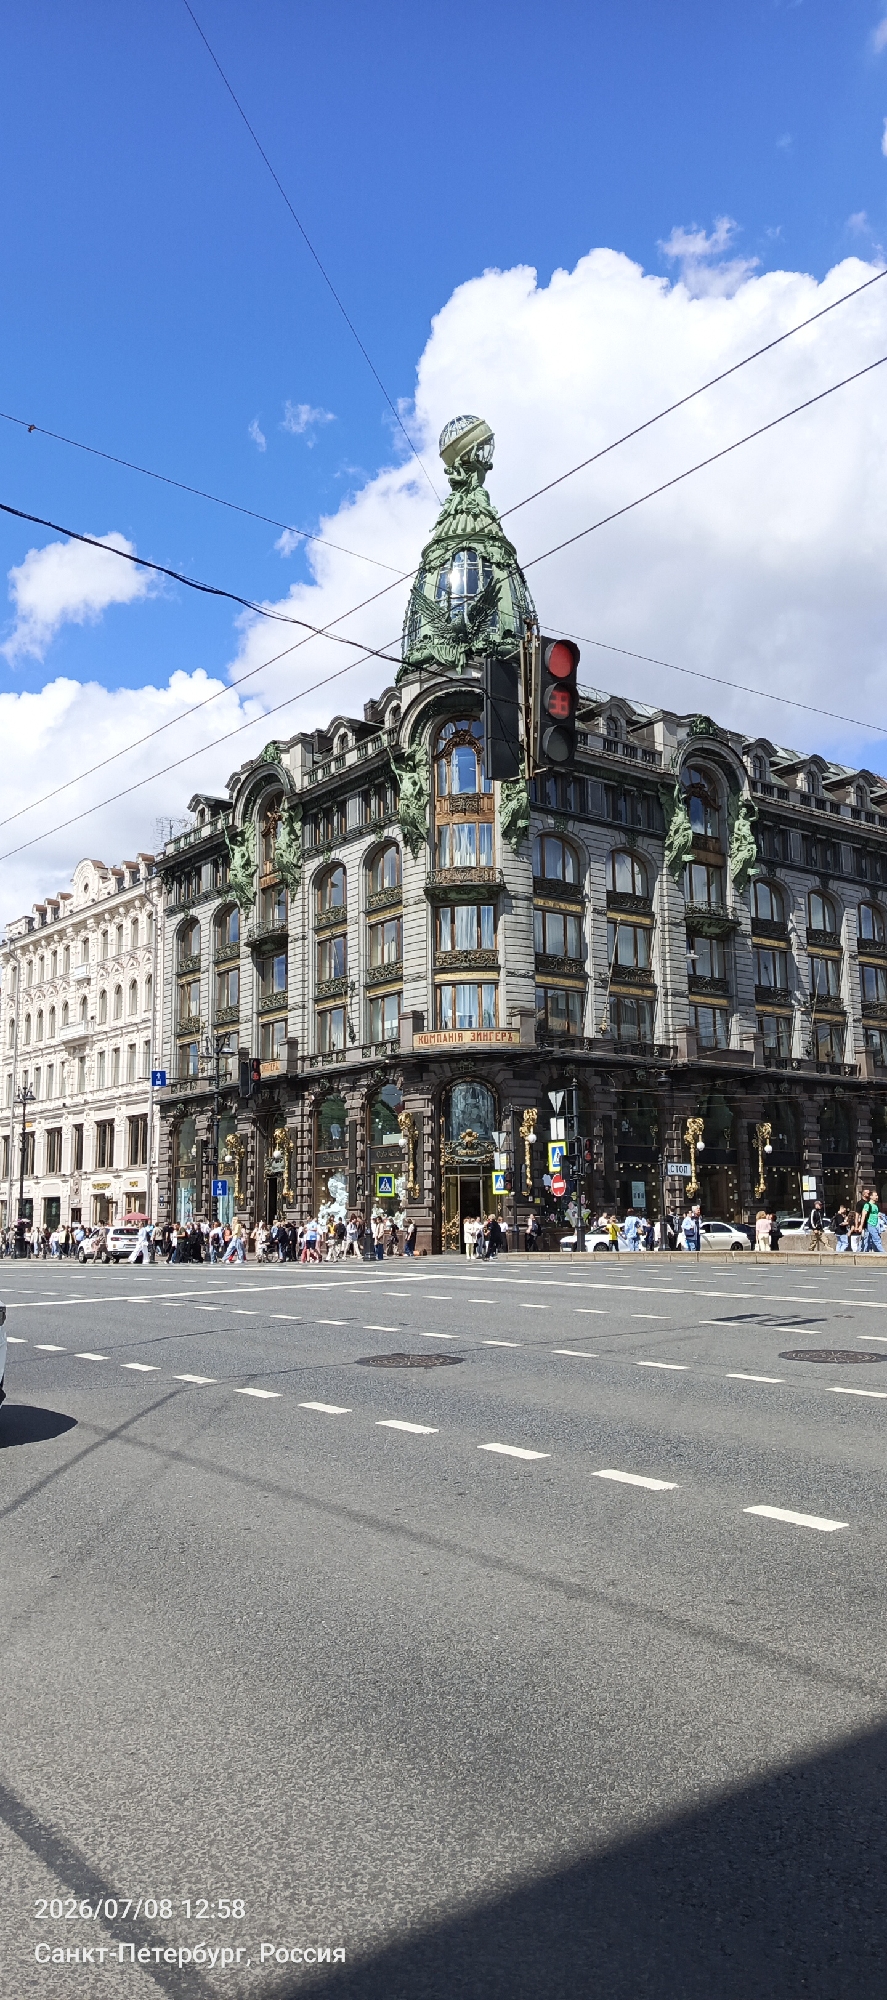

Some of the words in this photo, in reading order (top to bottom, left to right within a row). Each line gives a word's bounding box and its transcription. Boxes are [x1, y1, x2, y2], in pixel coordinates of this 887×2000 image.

[418, 1032, 464, 1045] КОМПАНІЯ
[470, 1032, 513, 1042] ЗИНГЕРЪ
[670, 1165, 688, 1174] СТОП
